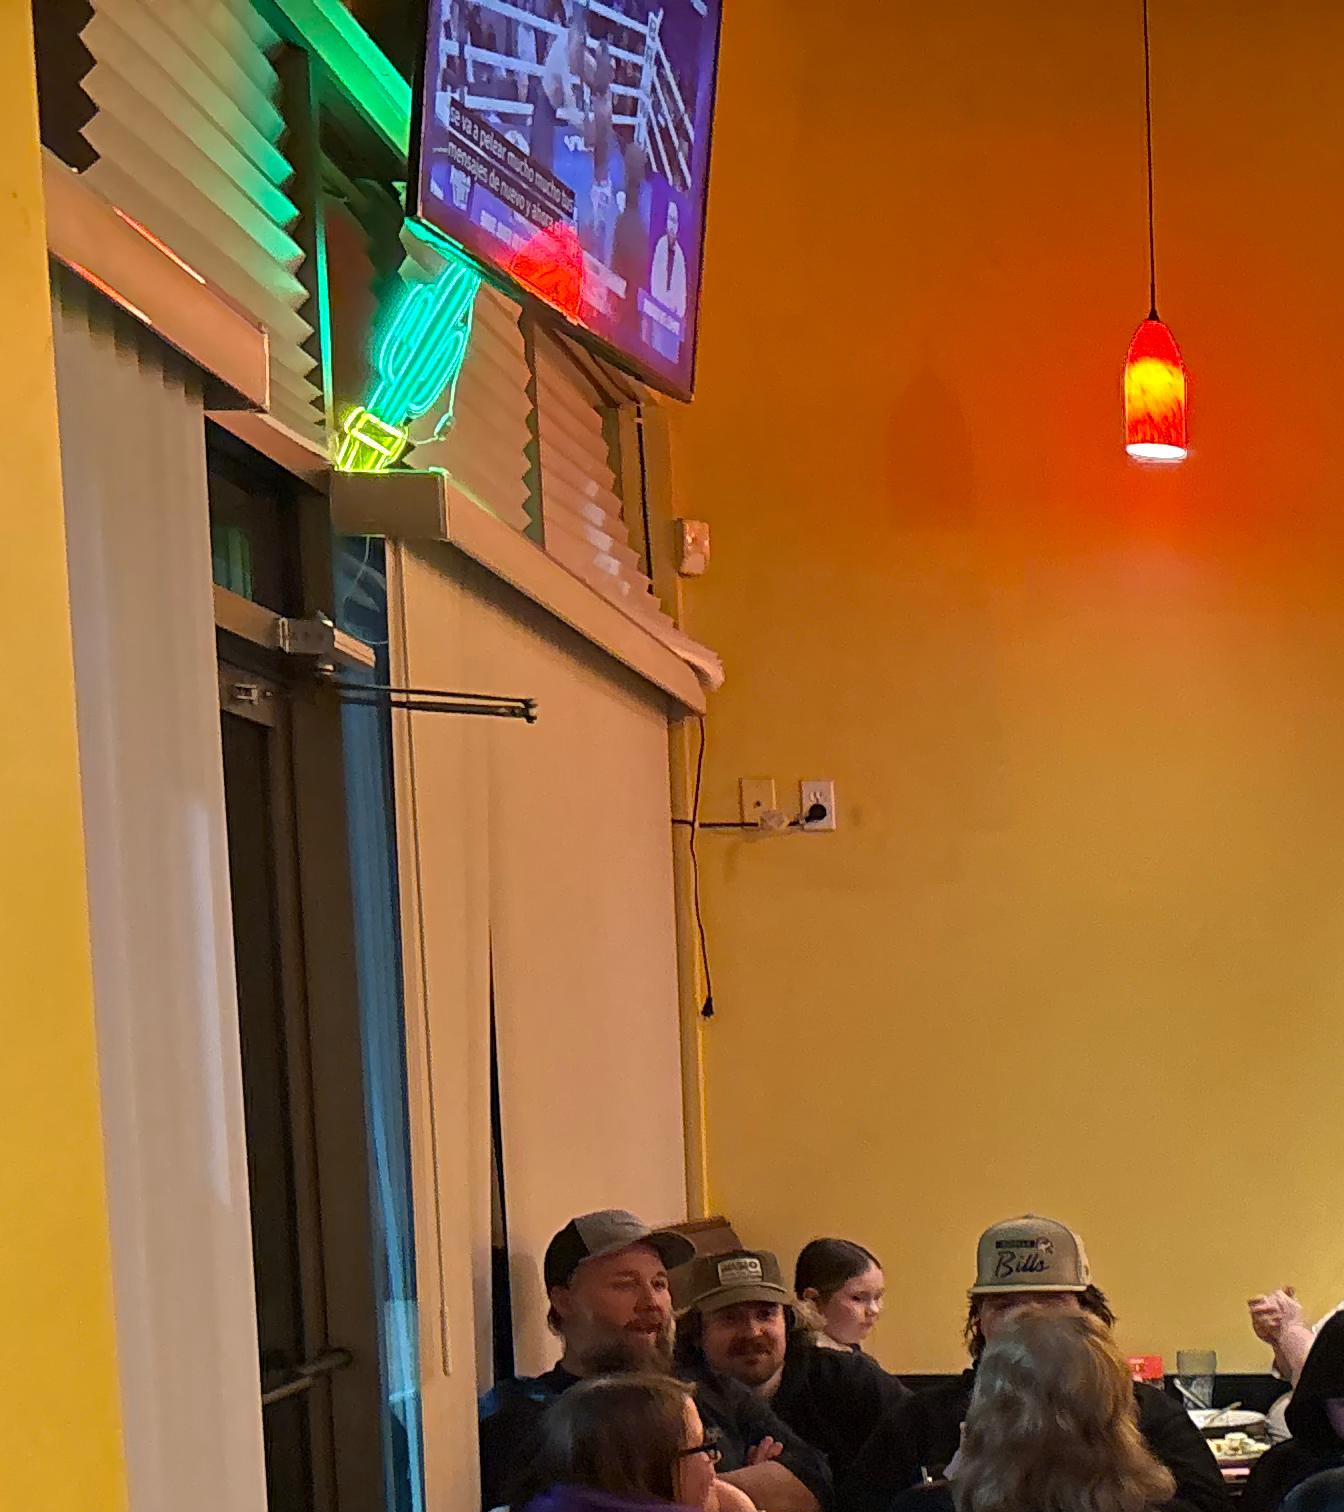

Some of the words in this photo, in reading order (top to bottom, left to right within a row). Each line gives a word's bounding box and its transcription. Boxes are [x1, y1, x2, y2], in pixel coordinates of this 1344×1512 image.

[448, 141, 488, 183] mensajes
[489, 165, 501, 192] de
[480, 130, 507, 160] pelear
[507, 151, 535, 182] mucho
[995, 1250, 1050, 1278] Bills
